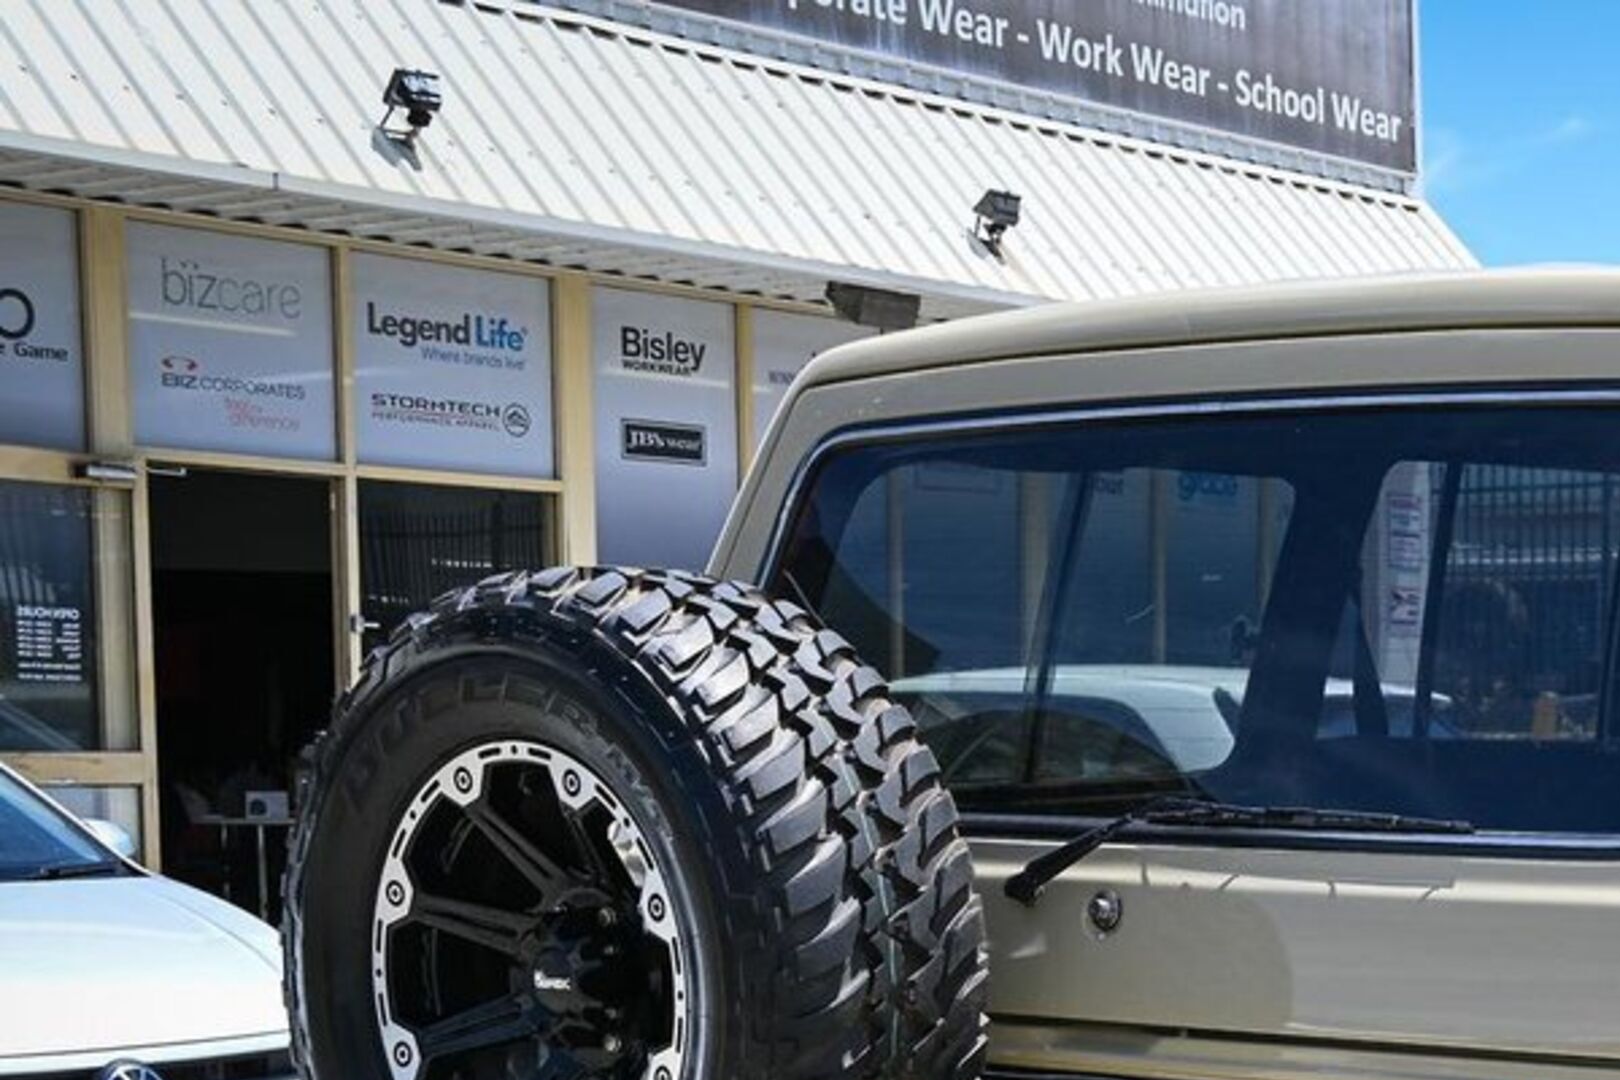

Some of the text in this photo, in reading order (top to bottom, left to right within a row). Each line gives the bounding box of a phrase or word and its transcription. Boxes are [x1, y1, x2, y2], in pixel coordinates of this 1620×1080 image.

[918, 0, 1008, 47] Wear
[1037, 19, 1124, 76] Work
[1131, 43, 1211, 96] Wear
[1235, 69, 1325, 125] School
[1331, 92, 1402, 143] Wear
[367, 302, 471, 347] Legend
[13, 341, 69, 361] Game
[421, 346, 461, 362] Where
[463, 352, 503, 368] brands
[621, 326, 705, 372] Bisley
[622, 359, 692, 377] WORKWEAR
[201, 377, 306, 400] CORPORATES
[371, 394, 500, 417] STORMTECH
